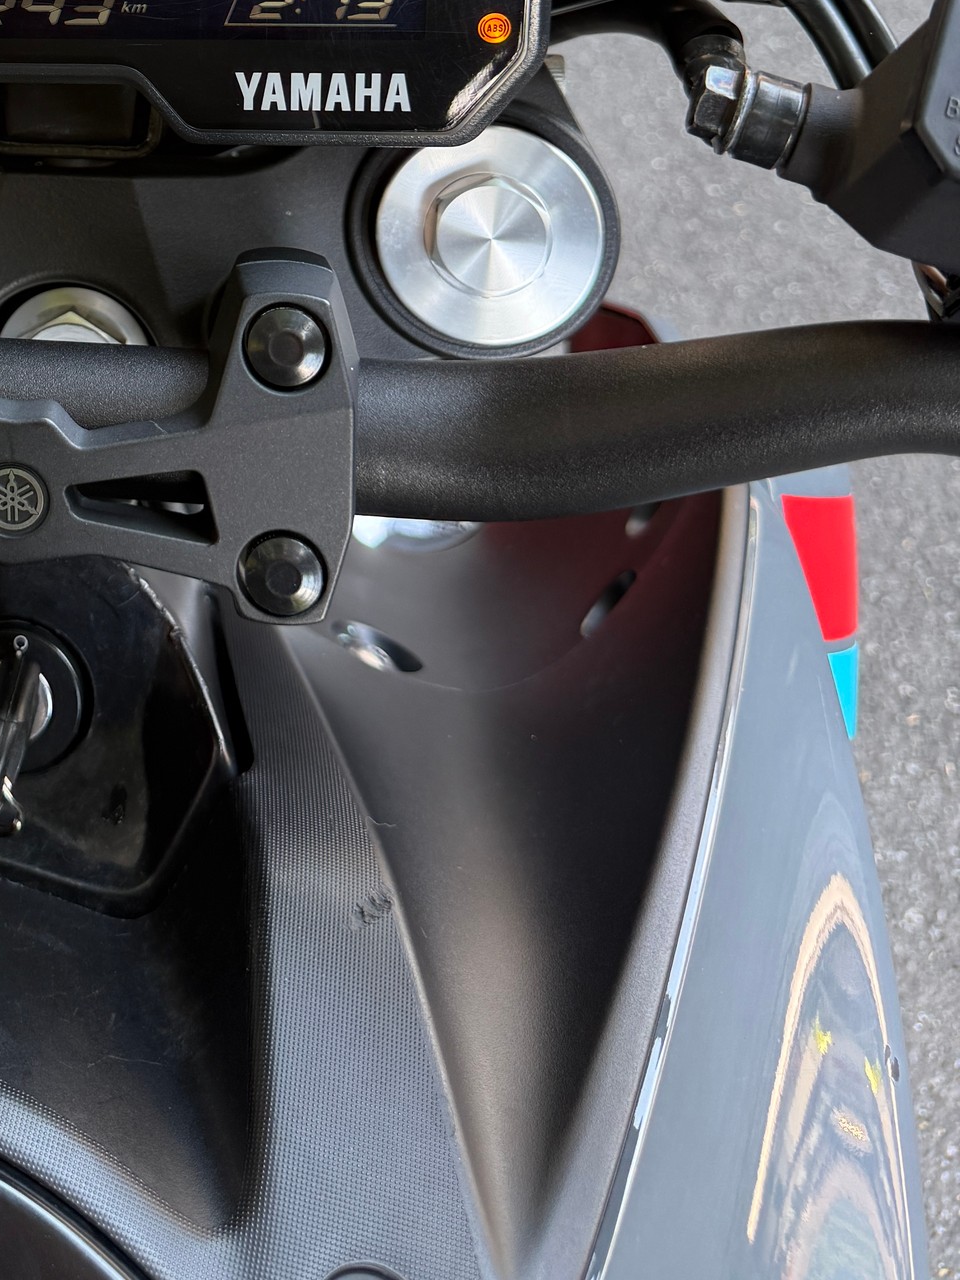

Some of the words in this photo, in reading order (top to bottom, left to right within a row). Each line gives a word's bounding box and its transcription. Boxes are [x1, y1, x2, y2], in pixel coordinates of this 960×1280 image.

[120, 0, 148, 14] km
[486, 22, 504, 33] ABS
[235, 72, 412, 112] YAMAHA
